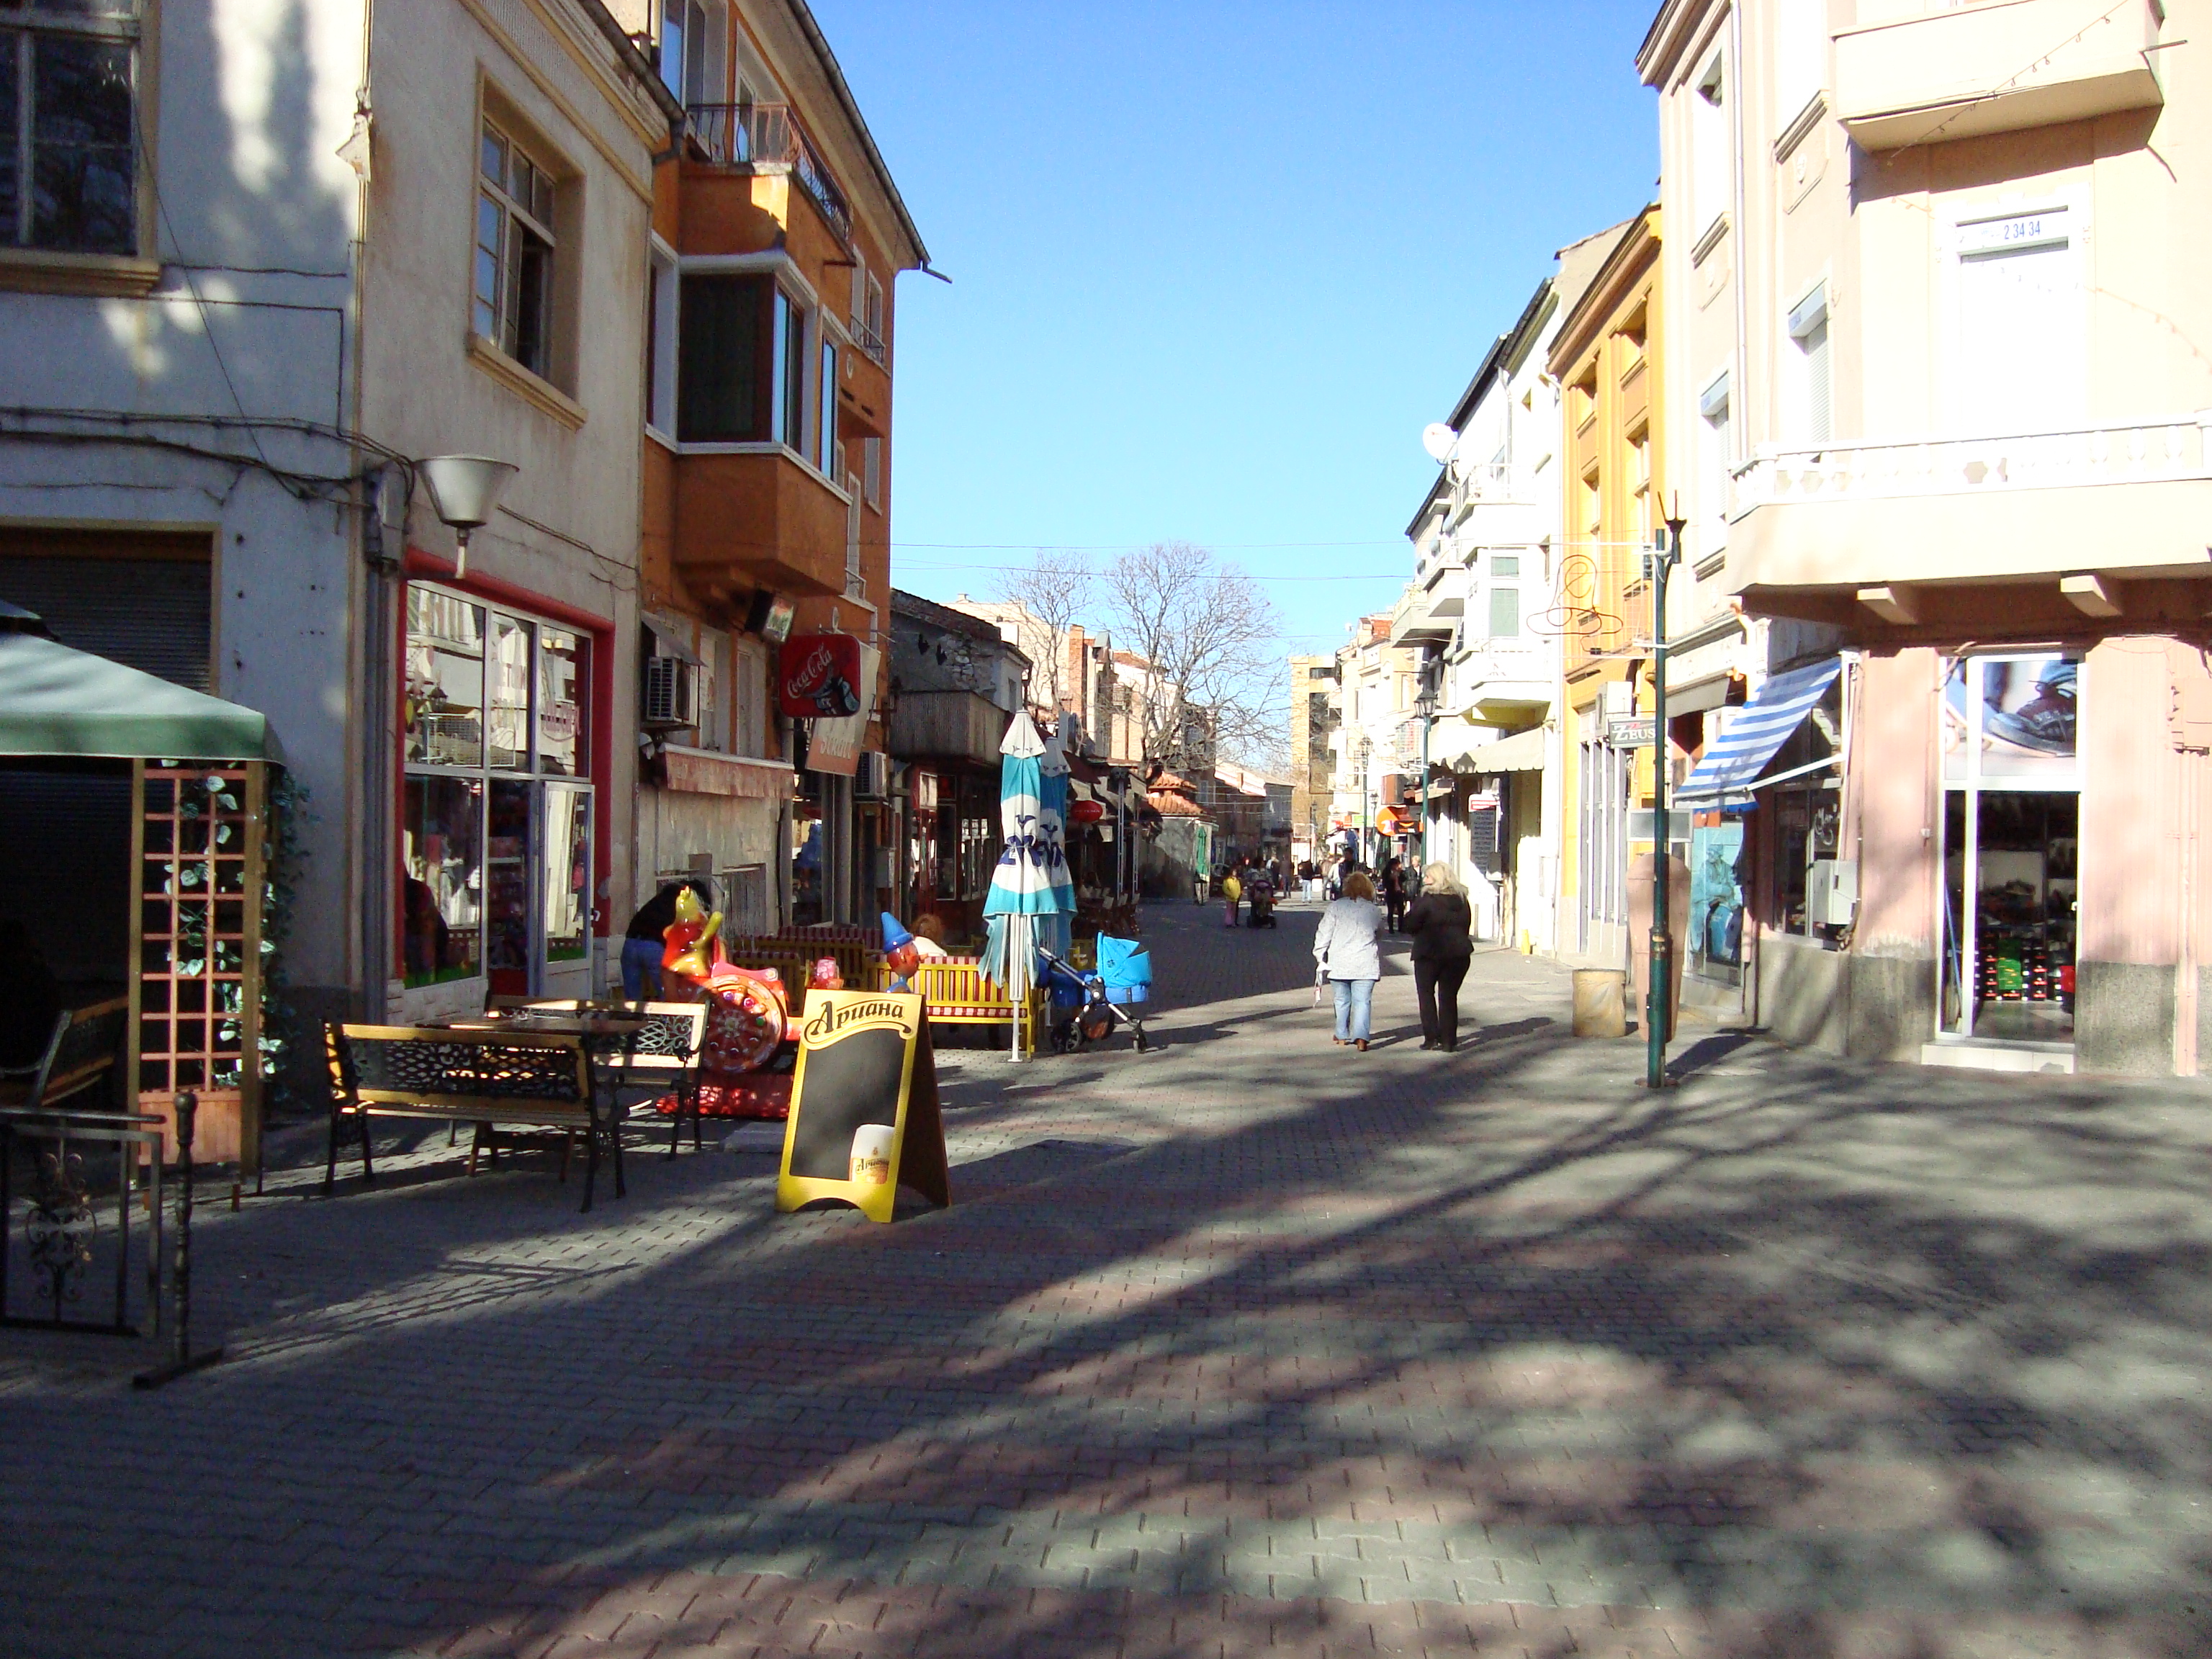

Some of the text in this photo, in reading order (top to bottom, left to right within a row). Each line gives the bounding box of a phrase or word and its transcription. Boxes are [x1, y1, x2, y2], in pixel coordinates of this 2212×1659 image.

[2004, 225, 2010, 240] 2
[2013, 222, 2025, 238] 34
[2028, 220, 2041, 236] 34
[787, 643, 832, 698] Coca-Cola
[1611, 725, 1655, 741] ZEUS
[805, 1000, 904, 1038] Ариана
